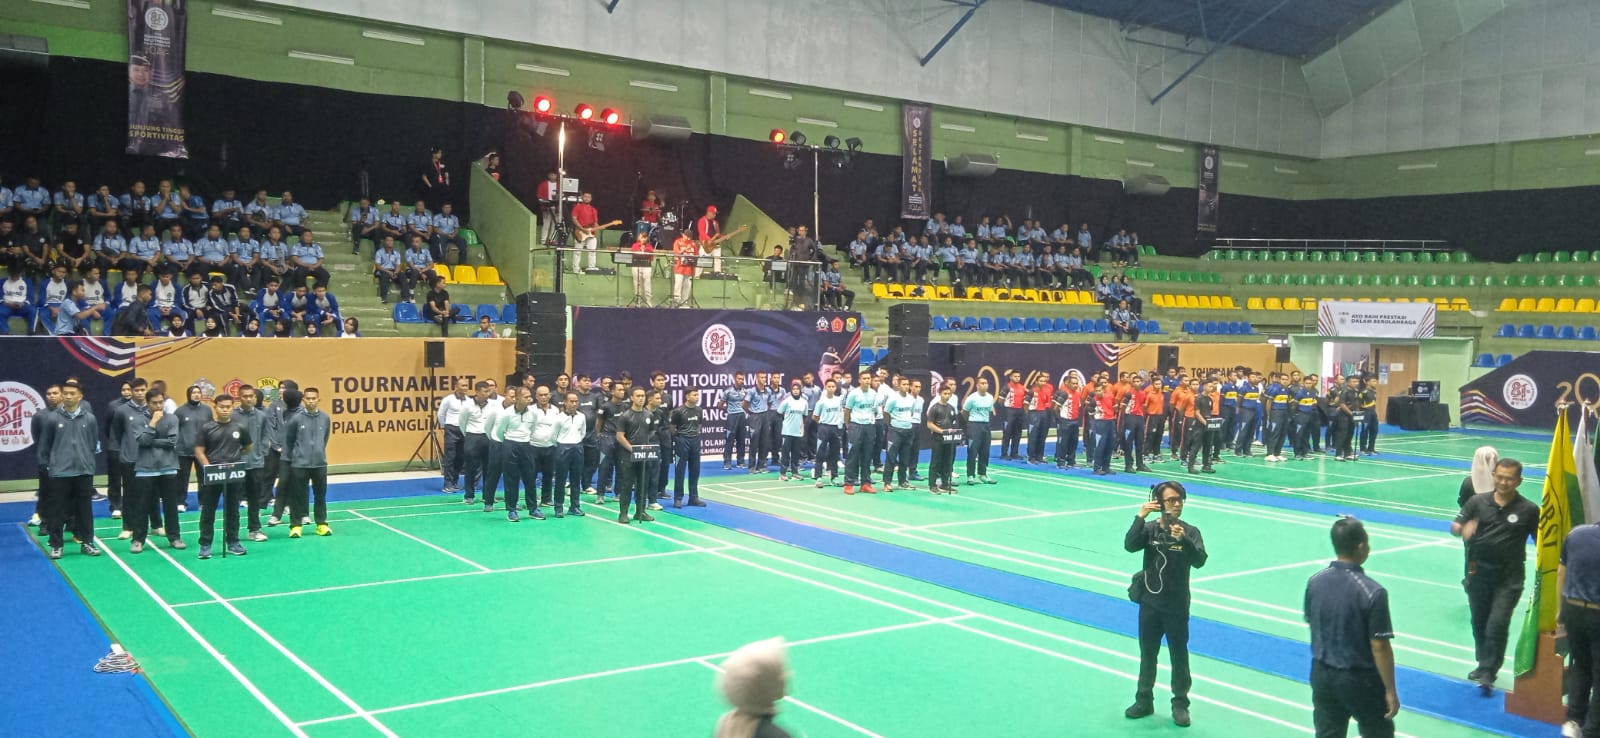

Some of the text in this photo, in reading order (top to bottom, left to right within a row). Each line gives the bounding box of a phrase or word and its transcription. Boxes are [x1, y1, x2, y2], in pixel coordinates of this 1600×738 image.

[129, 130, 184, 142] SPORTIVITAS
[7, 387, 40, 407] INDONESIA
[1511, 381, 1528, 399] 81
[332, 396, 442, 415] BULUTANG
[332, 418, 445, 434] PIALA PANGLIM
[207, 470, 246, 481] TNI AD
